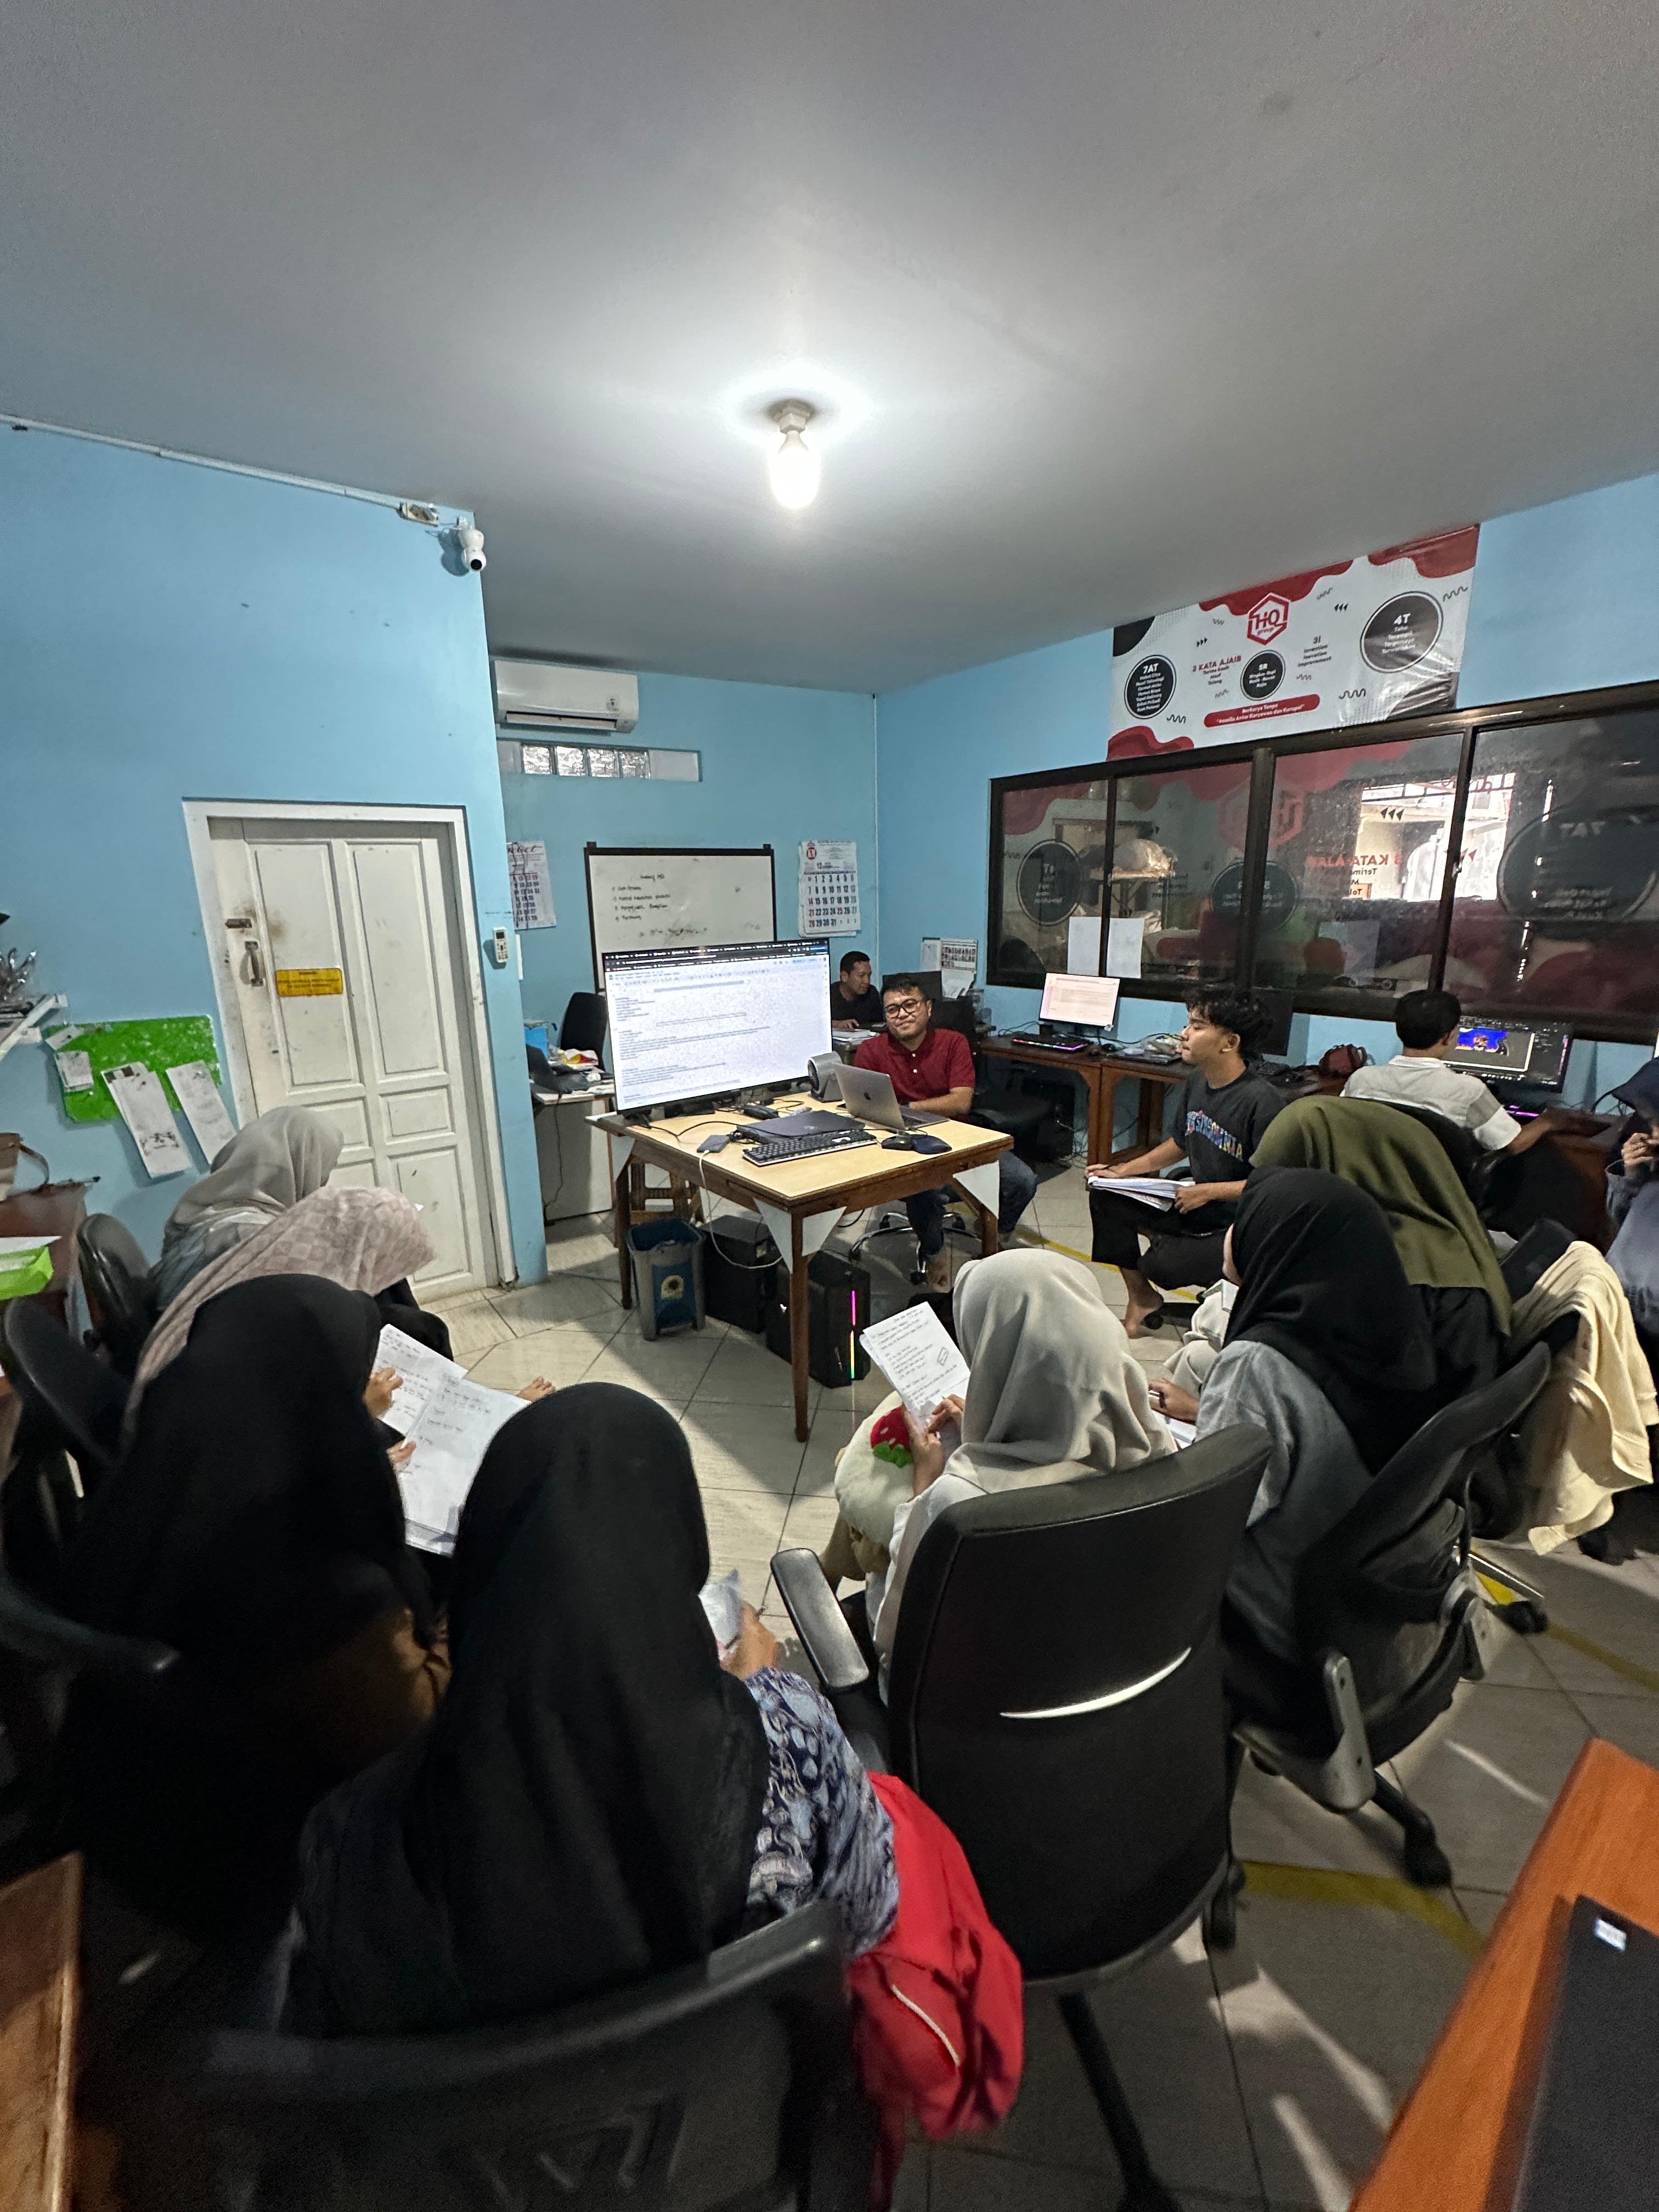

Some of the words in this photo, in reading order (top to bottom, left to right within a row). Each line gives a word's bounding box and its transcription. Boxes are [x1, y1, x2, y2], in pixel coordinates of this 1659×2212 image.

[1255, 610, 1280, 630] HQ
[1394, 613, 1411, 624] 4T
[1143, 663, 1159, 674] 7AT
[1199, 661, 1216, 670] KATA
[1220, 655, 1242, 666] AJAIB
